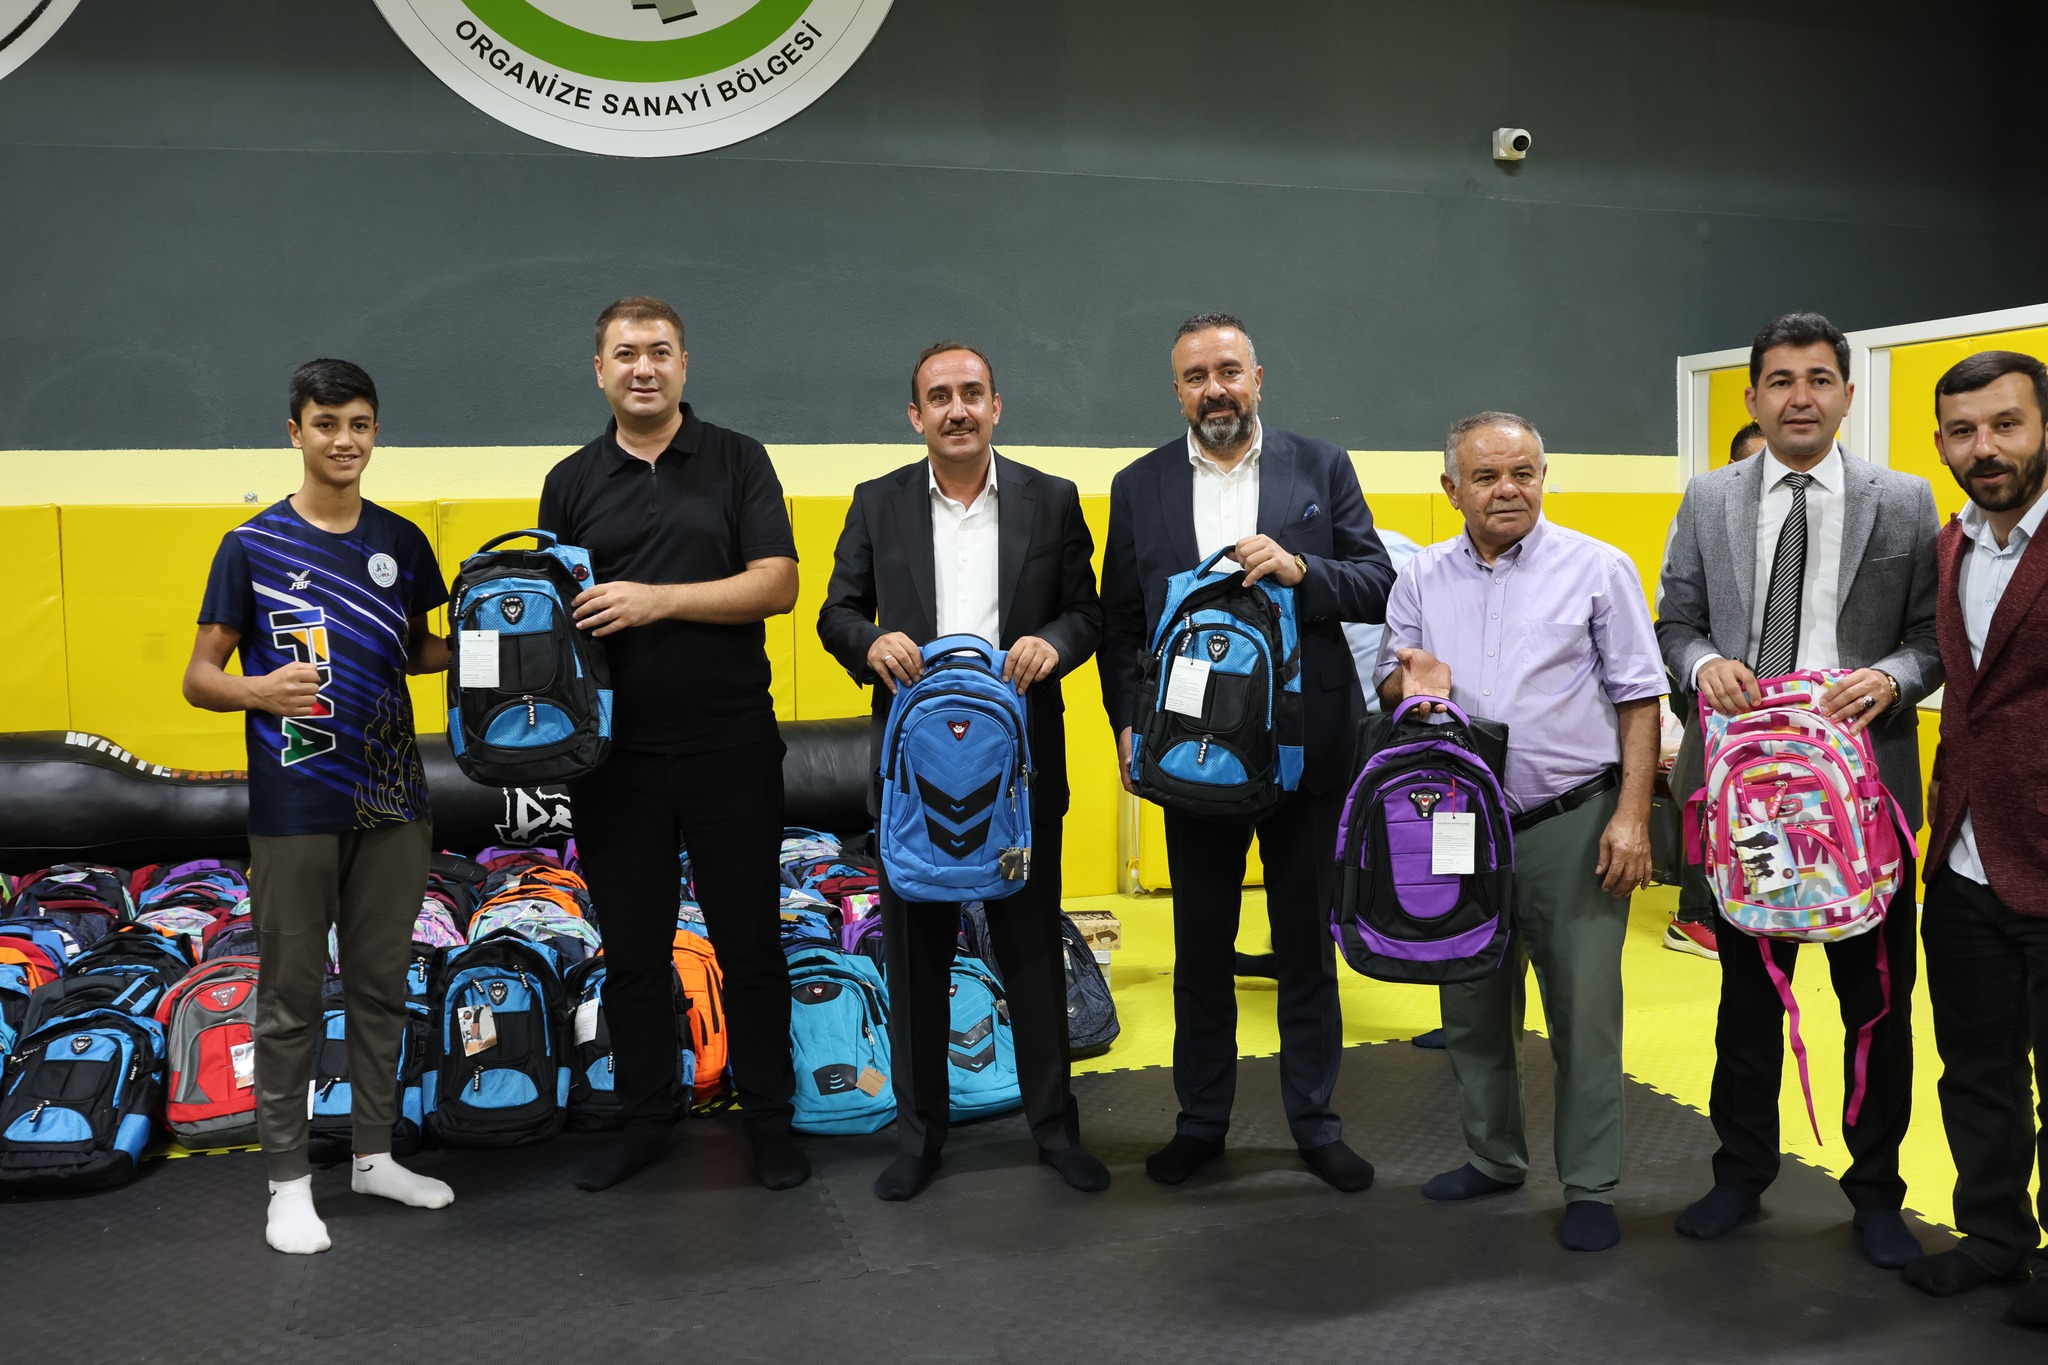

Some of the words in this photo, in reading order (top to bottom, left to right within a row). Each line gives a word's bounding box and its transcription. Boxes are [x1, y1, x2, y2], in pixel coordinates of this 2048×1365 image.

[456, 20, 593, 110] ORGANİZE
[601, 83, 712, 117] SANAYİ
[716, 19, 823, 102] BÖLGESİ
